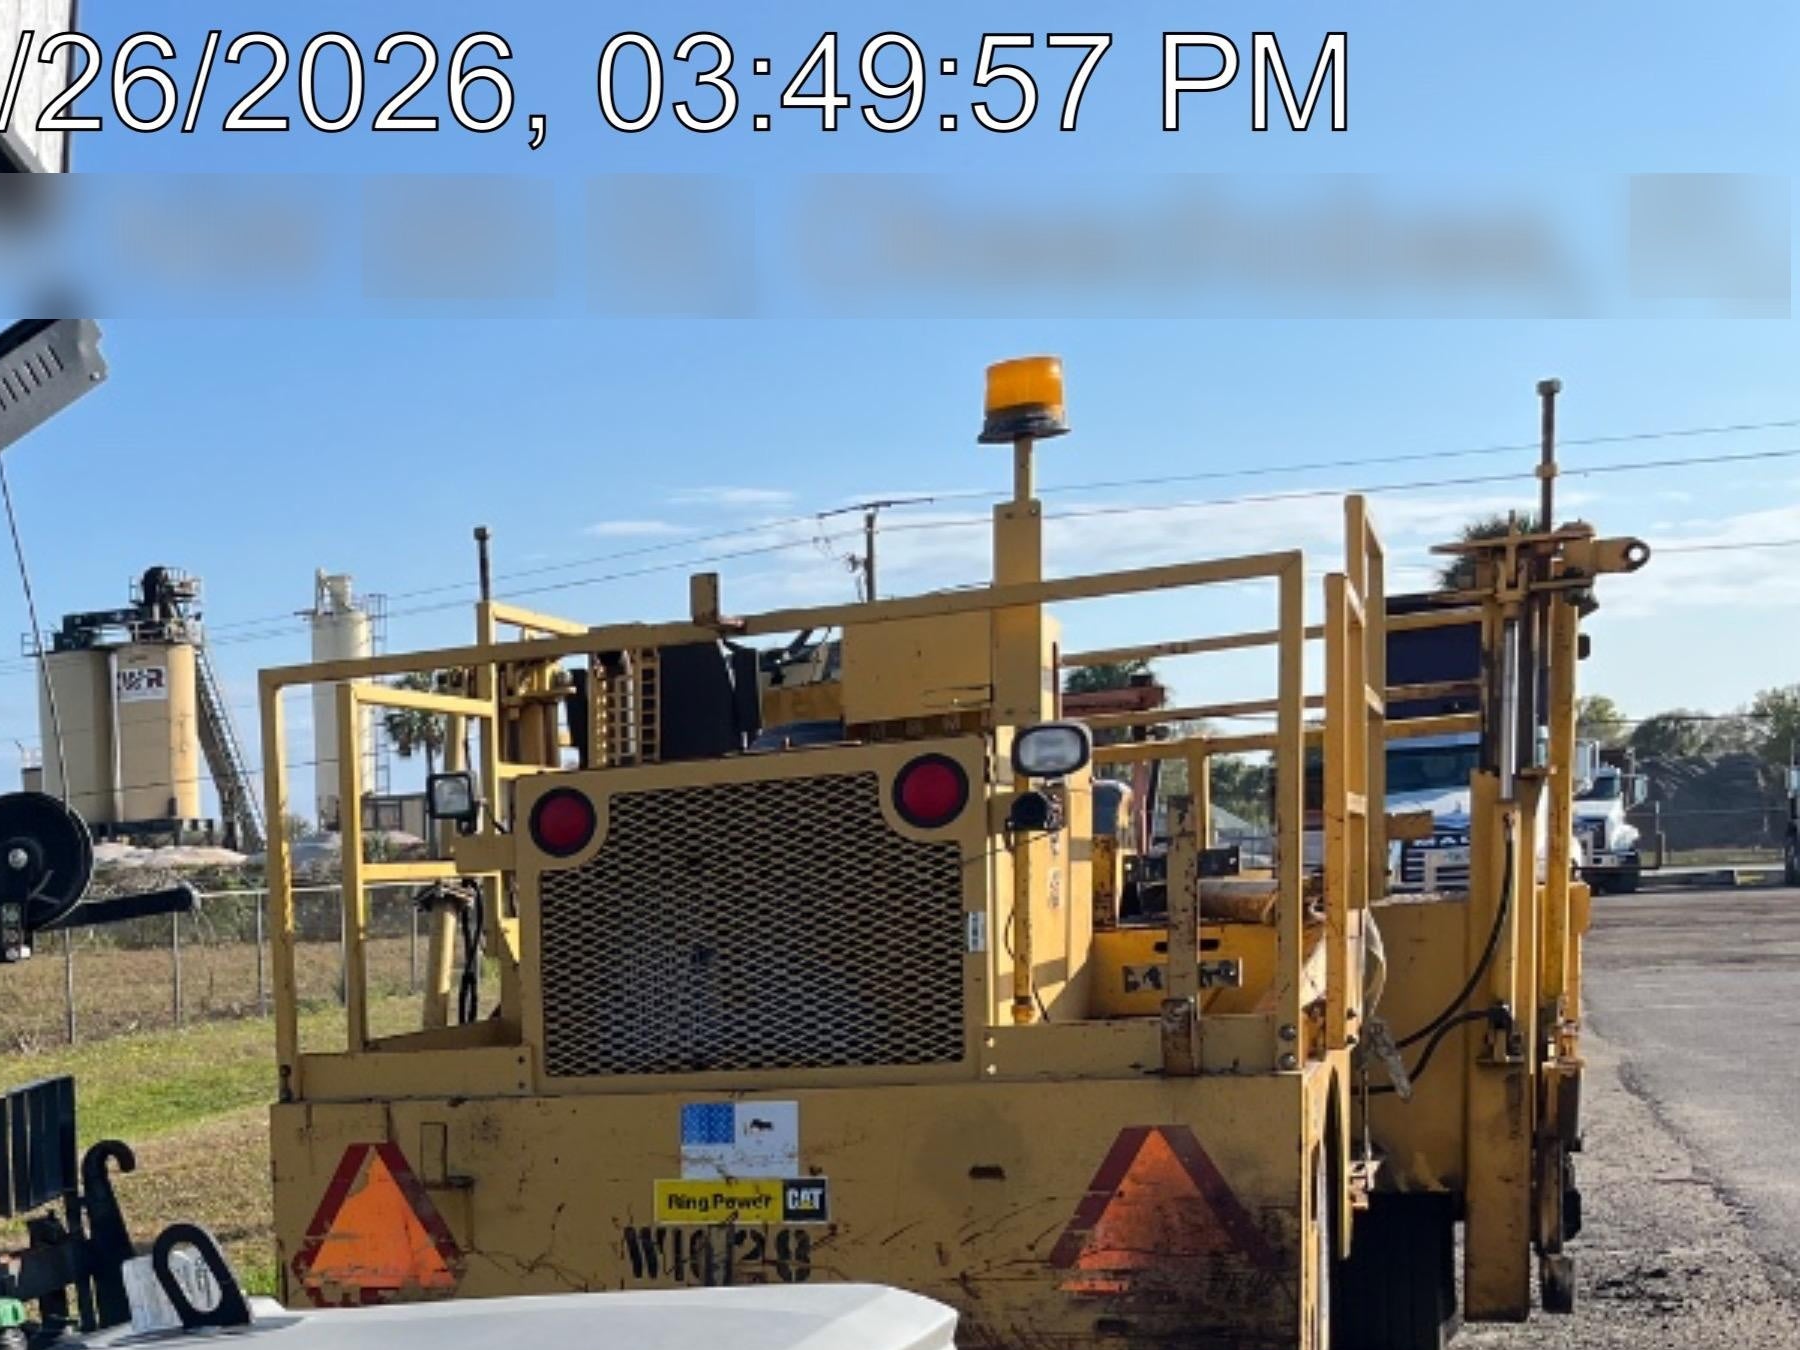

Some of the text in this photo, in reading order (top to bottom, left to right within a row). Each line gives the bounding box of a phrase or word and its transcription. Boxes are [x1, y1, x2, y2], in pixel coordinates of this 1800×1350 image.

[667, 1192, 772, 1213] Ring Power
[786, 1187, 823, 1211] CAT
